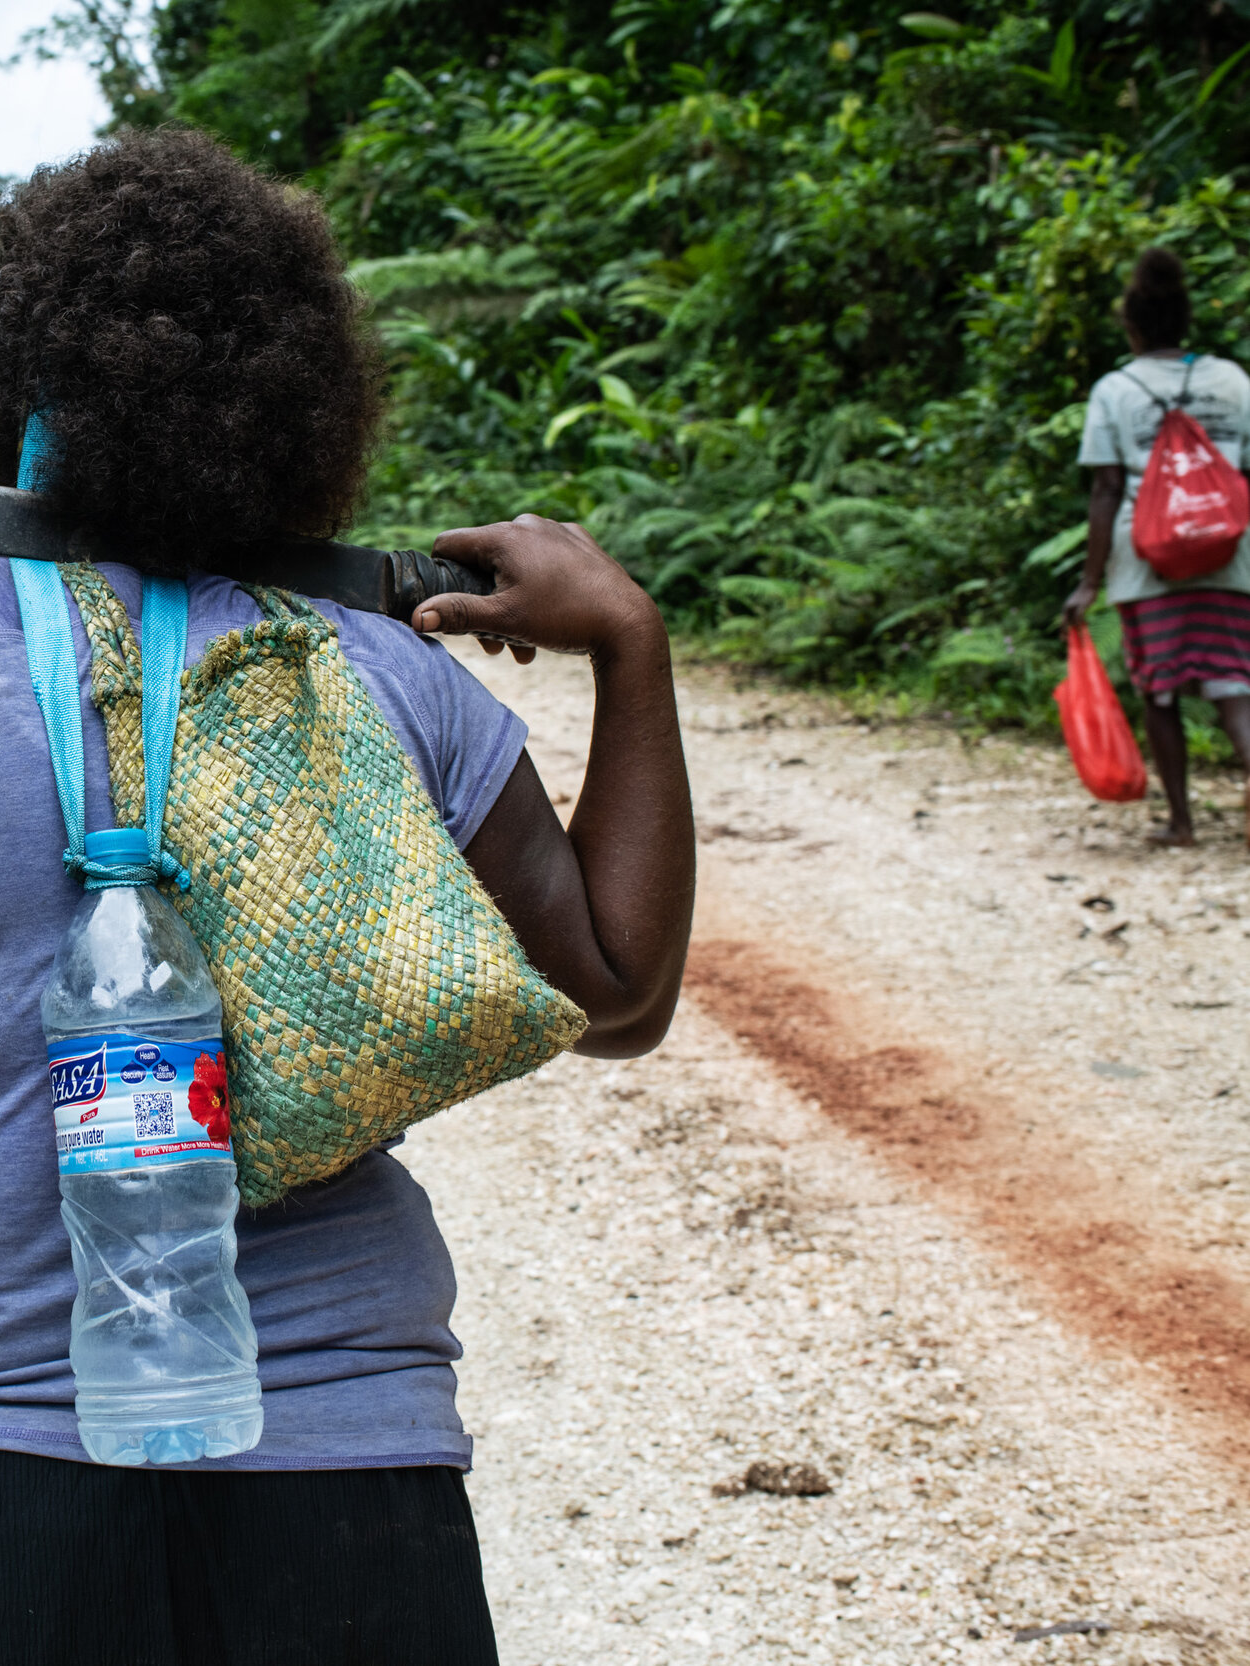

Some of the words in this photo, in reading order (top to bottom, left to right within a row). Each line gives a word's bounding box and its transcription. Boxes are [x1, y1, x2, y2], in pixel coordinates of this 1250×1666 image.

[139, 1051, 157, 1060] Health
[157, 1064, 170, 1072] Rest
[122, 1071, 144, 1080] Security
[156, 1070, 175, 1079] assured
[82, 1111, 96, 1121] Pure
[68, 1132, 81, 1153] pure
[82, 1127, 104, 1146] water
[141, 1147, 160, 1156] Drink
[160, 1144, 181, 1153] Water
[181, 1142, 197, 1150] More
[196, 1141, 210, 1149] More
